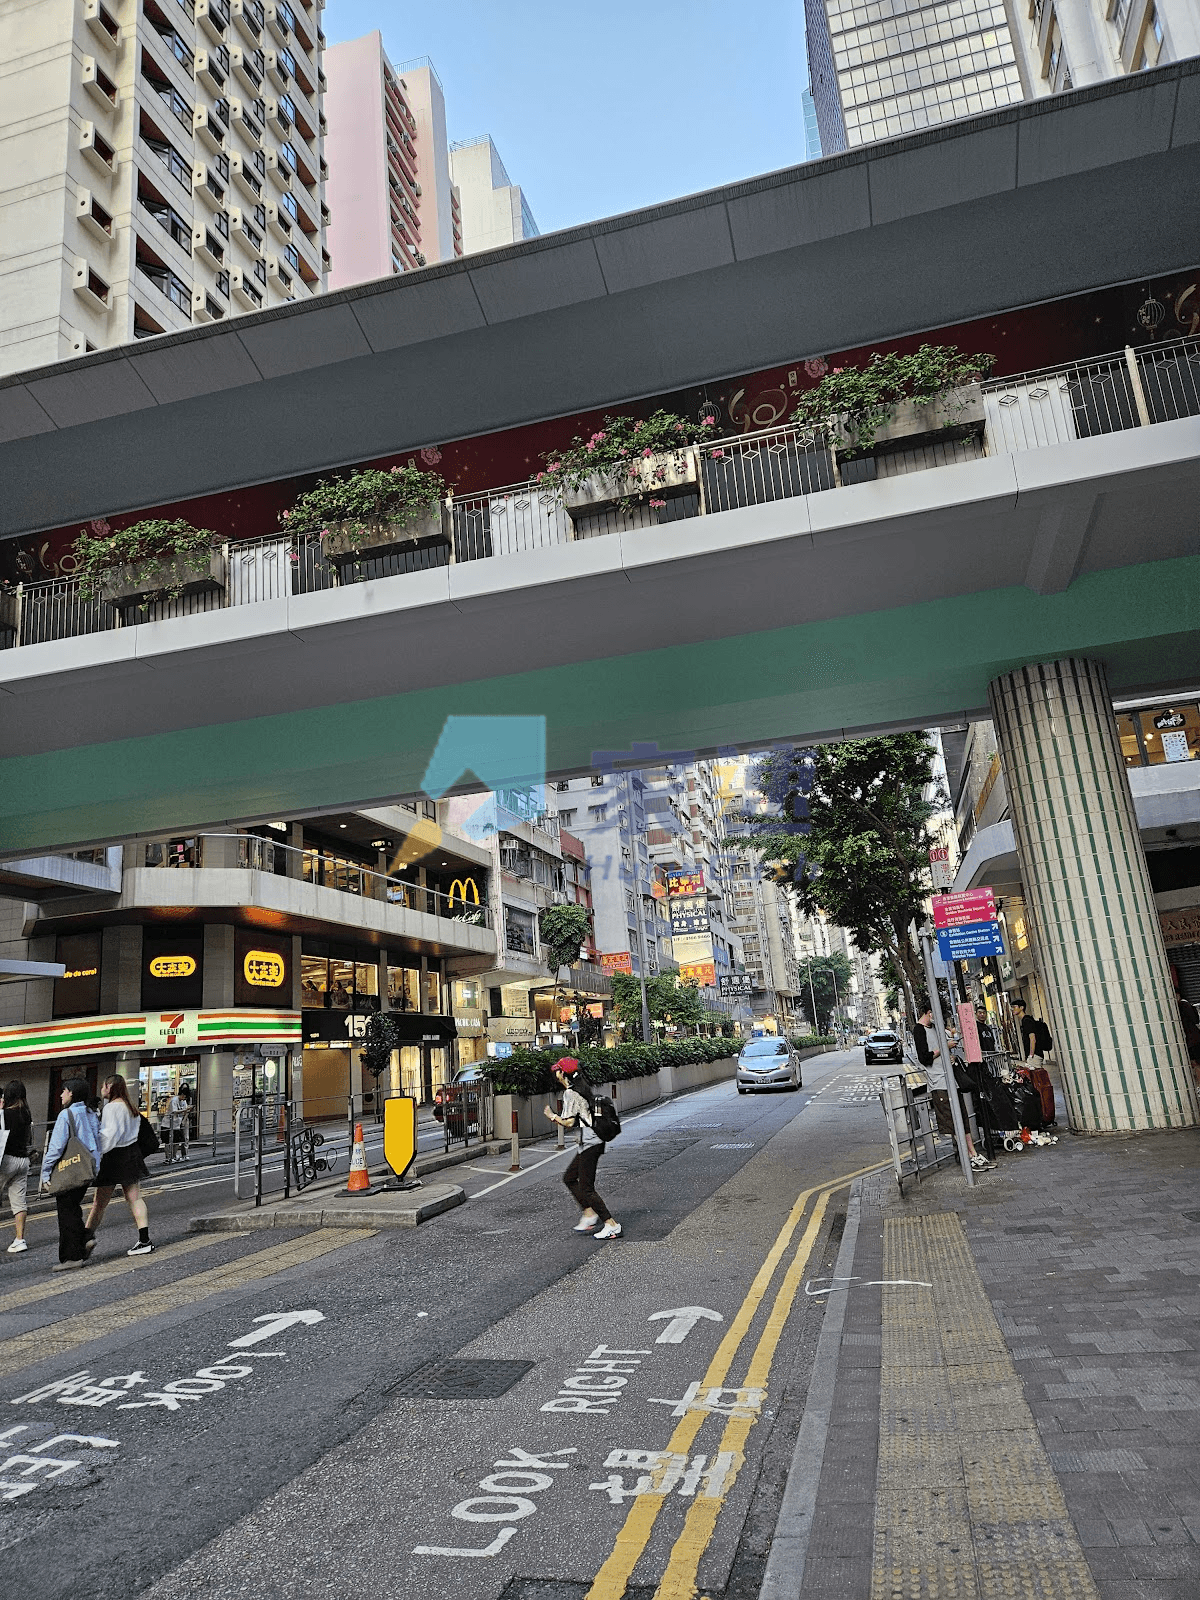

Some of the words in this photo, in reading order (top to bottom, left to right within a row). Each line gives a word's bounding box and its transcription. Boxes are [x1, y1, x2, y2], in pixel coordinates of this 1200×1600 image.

[672, 910, 708, 919] PHYSICAL
[721, 985, 752, 994] PHYSICAL
[160, 1013, 185, 1044] 7
[58, 1155, 81, 1171] Merci
[117, 1352, 286, 1411] LOOK
[412, 1447, 578, 1558] LOOK
[539, 1344, 653, 1414] RIGHT
